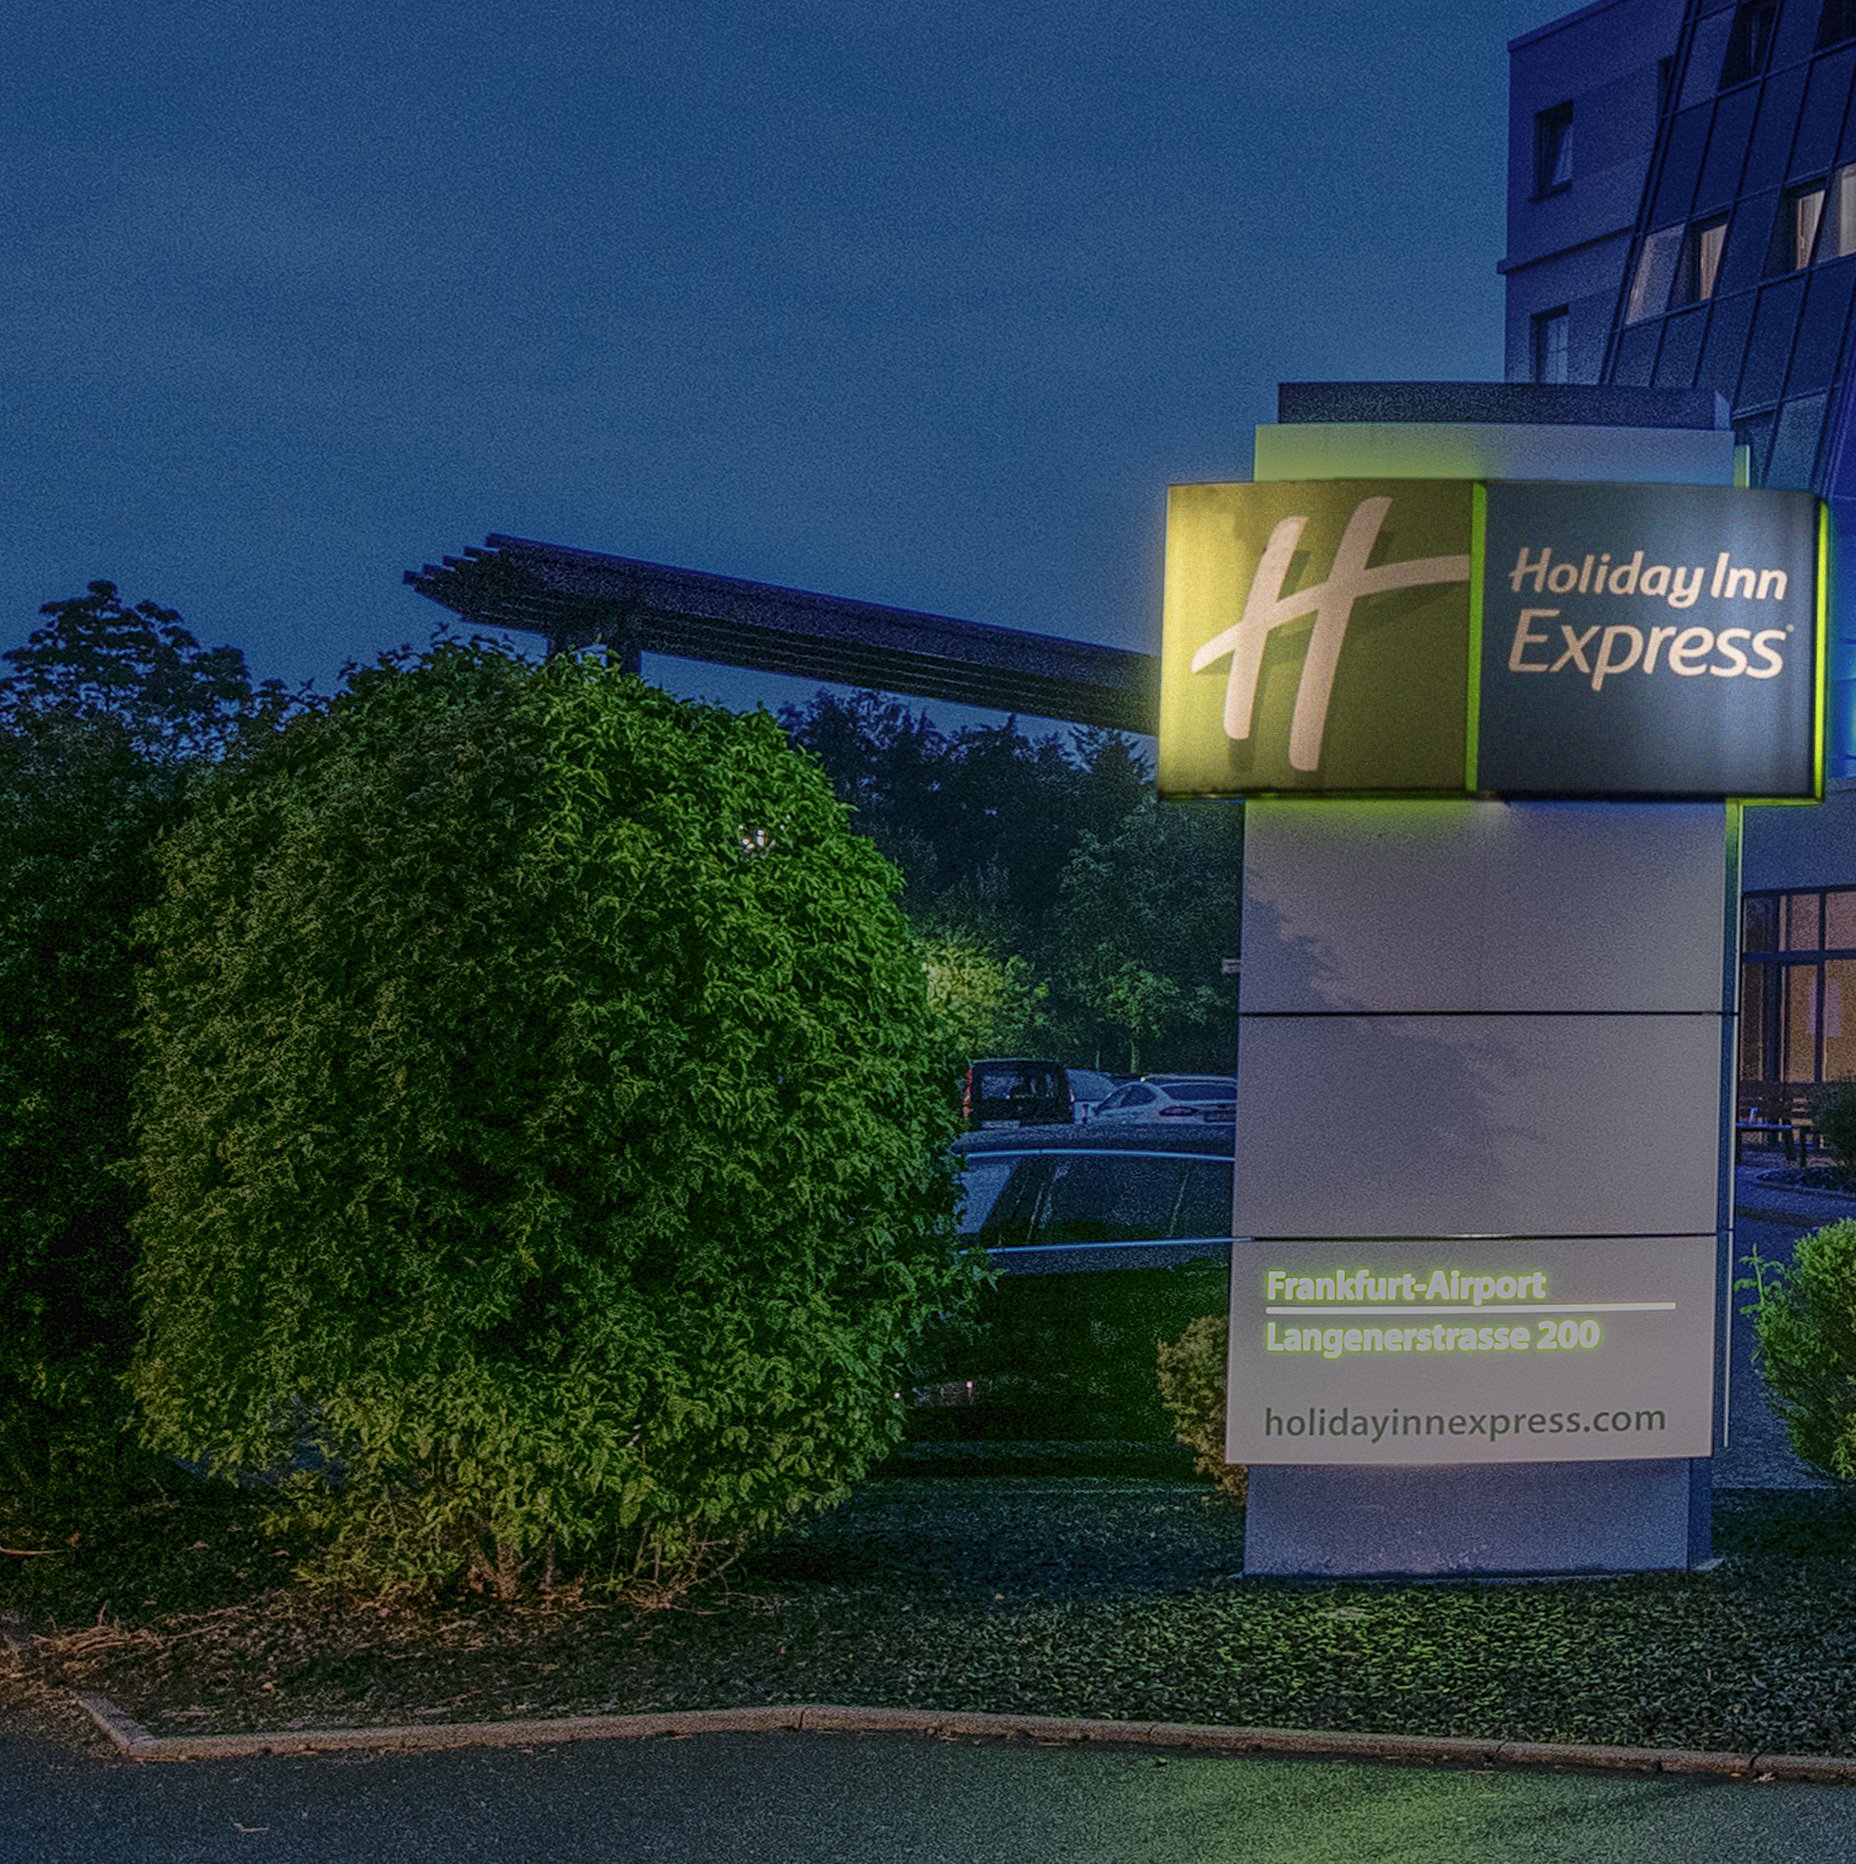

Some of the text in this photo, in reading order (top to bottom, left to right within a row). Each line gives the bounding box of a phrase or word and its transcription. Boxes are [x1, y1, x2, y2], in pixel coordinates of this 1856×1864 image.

[1508, 547, 1788, 607] Holiday Inn
[1508, 608, 1787, 691] Express
[1267, 1270, 1546, 1306] Frankfurt-Airport
[1267, 1320, 1600, 1358] Langenerstrasse 200
[1264, 1407, 1667, 1443] holidayinnexpress.com
